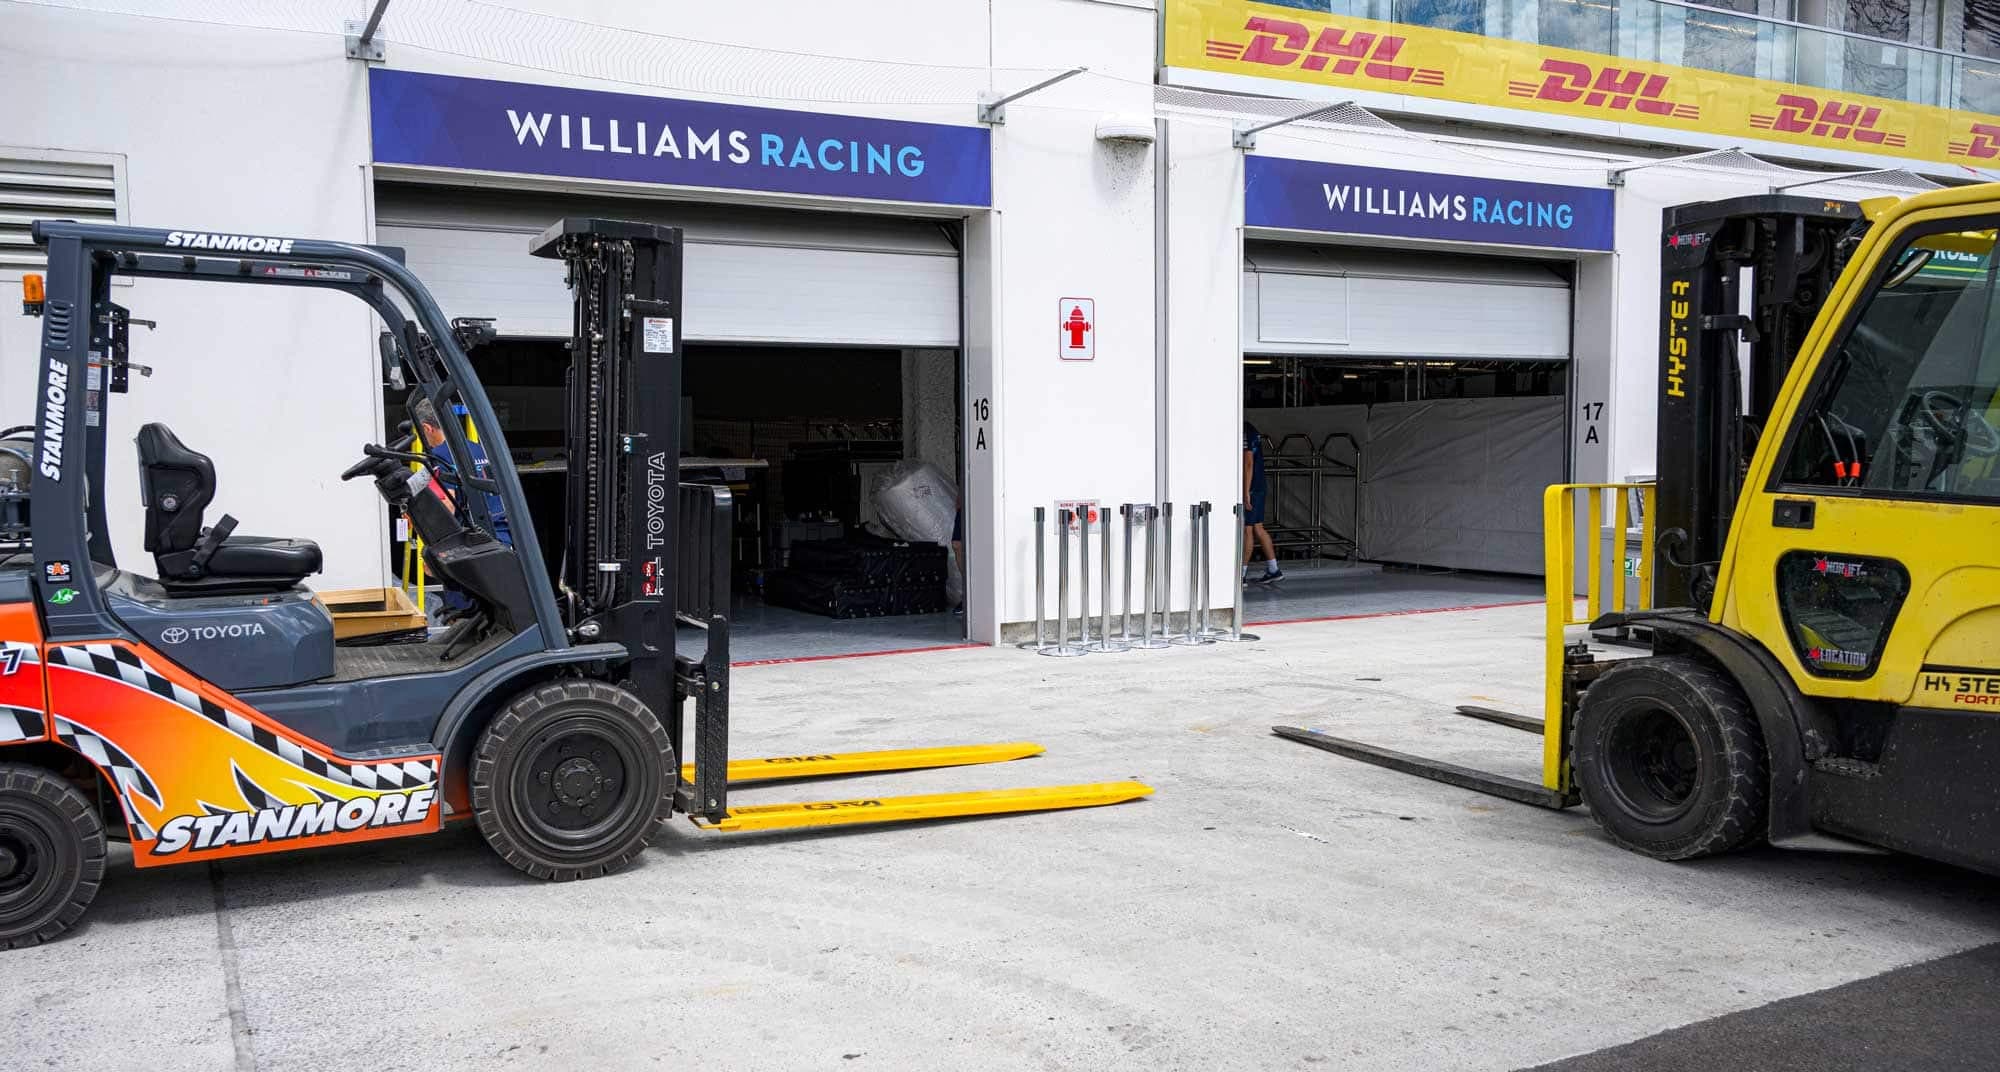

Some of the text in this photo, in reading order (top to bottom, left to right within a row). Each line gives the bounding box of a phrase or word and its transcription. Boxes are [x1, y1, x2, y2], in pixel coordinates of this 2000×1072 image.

[1240, 16, 1415, 82] DHL
[1535, 58, 1676, 116] DHL
[506, 109, 925, 178] WILLIAMS RACING
[1772, 94, 1887, 145] DHL
[1323, 183, 1574, 230] WILLIAMS RACING
[166, 231, 294, 255] STANMORE
[1667, 280, 1690, 397] HYSTER
[40, 358, 69, 481] STANMORE
[973, 398, 989, 421] 16
[1582, 403, 1604, 421] 17
[1585, 425, 1599, 444] A
[976, 427, 986, 450] A
[648, 452, 665, 550] TOYOTA
[192, 623, 265, 639] TOYOTA
[150, 788, 437, 856] STANMORE
